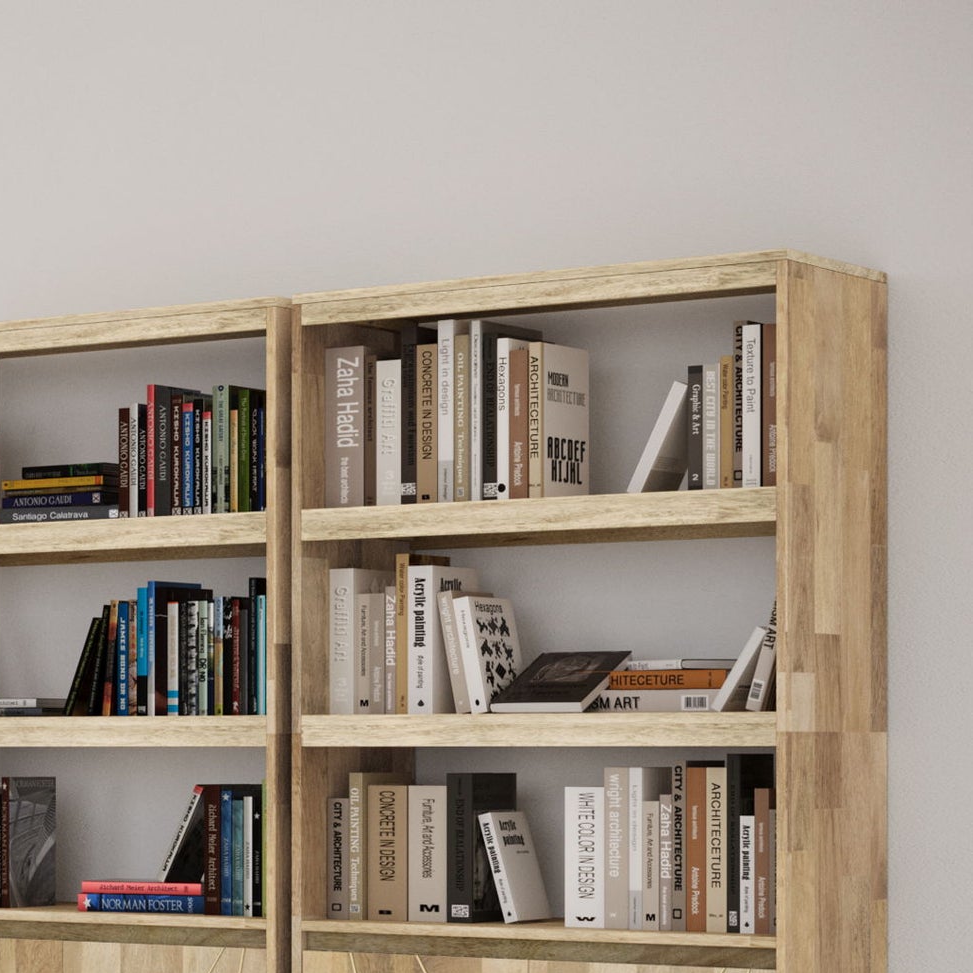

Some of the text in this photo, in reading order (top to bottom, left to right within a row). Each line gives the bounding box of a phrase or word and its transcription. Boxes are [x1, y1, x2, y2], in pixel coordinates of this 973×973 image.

[457, 352, 466, 372] OIL
[735, 326, 743, 351] CITY
[440, 338, 451, 416] Light in design
[457, 374, 466, 428] PAINTING
[497, 357, 508, 411] Hexagons
[547, 370, 569, 388] MODERN
[690, 384, 702, 412] Graphic
[706, 370, 717, 393] BEST
[746, 338, 757, 413] Texture to Paint
[337, 357, 360, 448] Zaha Hadid
[421, 350, 433, 461] CONCRETE IN DESIGN
[530, 356, 540, 460] ARCHITECETURE
[690, 421, 702, 435] Art
[735, 366, 743, 453] ARCHITECTURE
[120, 421, 128, 488] ANTONIO GAUDI
[158, 404, 167, 482] ANTONIO GAUDI
[547, 436, 586, 463] ABCDEF
[12, 495, 72, 507] ANTONIO GAUDI
[692, 473, 699, 481] 2
[12, 510, 89, 523] Santiago Calatrava
[386, 594, 396, 627] Zaha
[413, 577, 426, 648] Acrylic painting
[198, 617, 208, 683] Ian Fleming DR NO
[386, 630, 396, 667] Hadid
[119, 683, 126, 695] DR
[119, 698, 126, 710] NO
[611, 674, 685, 686] HITECETURE
[614, 696, 640, 709] ART
[332, 801, 343, 821] CITY
[379, 790, 396, 882] CONCRETE IN DESIGN
[607, 773, 623, 878] wright architecture
[674, 765, 683, 892] CITY & ARCHITECTURE
[711, 782, 721, 888] ARCHITECETURE
[741, 824, 751, 850] Acrylic
[208, 804, 217, 891] Richard Meier Architect
[332, 830, 343, 892] ARCHITECTURE
[350, 787, 360, 901] OIL PAINTING Techniques
[482, 823, 501, 874] Acrylic painting
[578, 792, 595, 900] WHITE COLOR IN DESIGN
[660, 803, 672, 879] Zaha Hadid
[741, 850, 751, 881] painting
[101, 898, 184, 911] NORMAN FOSTER
